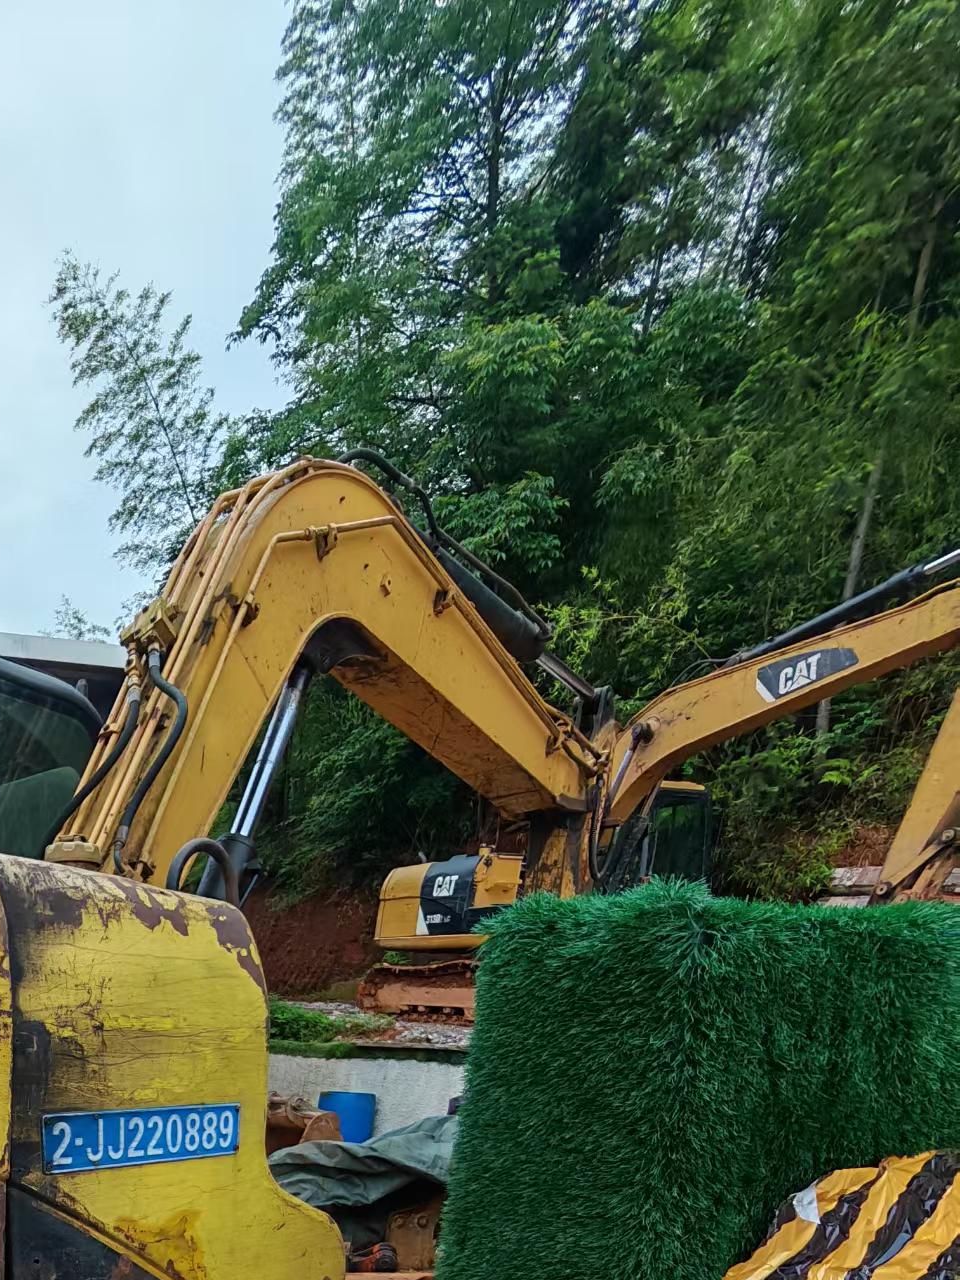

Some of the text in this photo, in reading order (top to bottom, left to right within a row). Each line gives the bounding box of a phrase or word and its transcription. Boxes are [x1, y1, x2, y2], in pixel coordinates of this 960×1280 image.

[778, 652, 822, 695] CAT
[432, 875, 459, 897] CAT
[52, 1110, 235, 1165] 2-JJ220889
